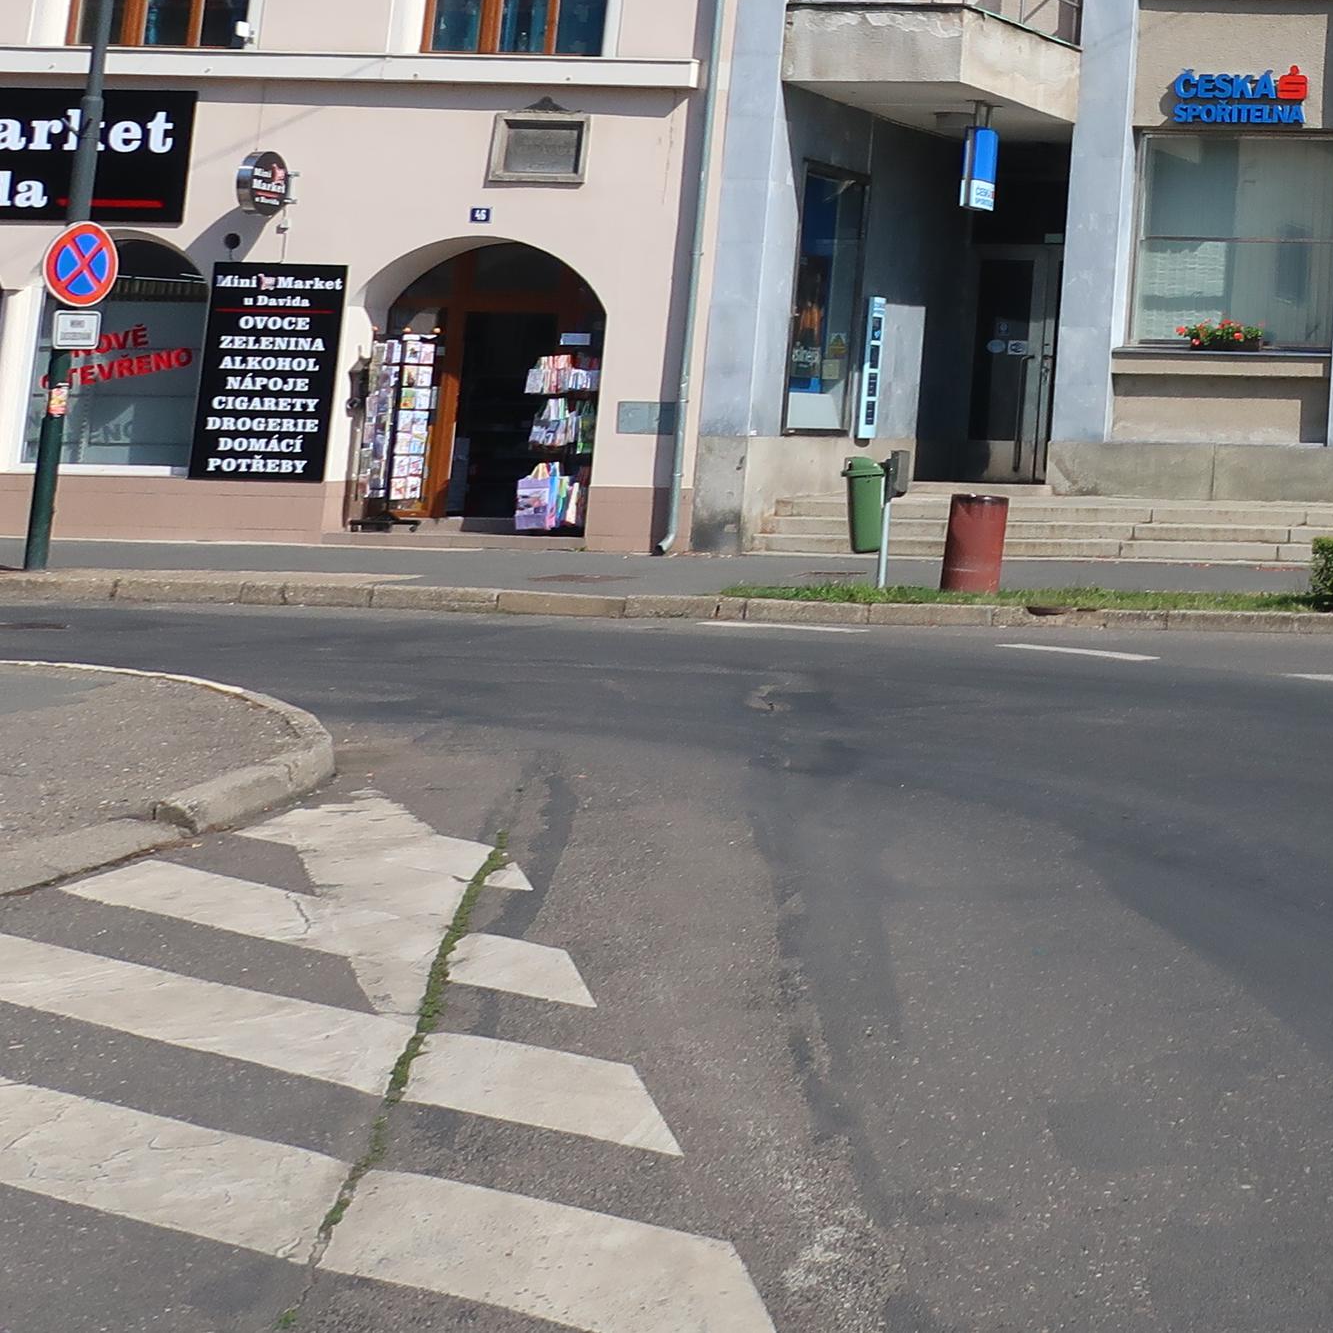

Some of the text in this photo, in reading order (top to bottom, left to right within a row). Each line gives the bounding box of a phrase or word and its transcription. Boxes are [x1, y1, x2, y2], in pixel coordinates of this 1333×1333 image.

[1174, 68, 1277, 99] ČESKÁ
[1173, 100, 1306, 124] SPOŘITELNA
[216, 275, 343, 290] Mini Market
[243, 295, 311, 307] u Davida
[239, 315, 310, 330] OVOCE
[219, 335, 326, 351] ZELENINA
[219, 356, 320, 371] ALKOHOL
[225, 373, 310, 391] NÁPOJE
[211, 396, 320, 412] CIGARETY
[205, 416, 319, 432] DROGERIE
[216, 434, 304, 453] DOMÁCÍ
[206, 455, 308, 474] POTŘEBY
